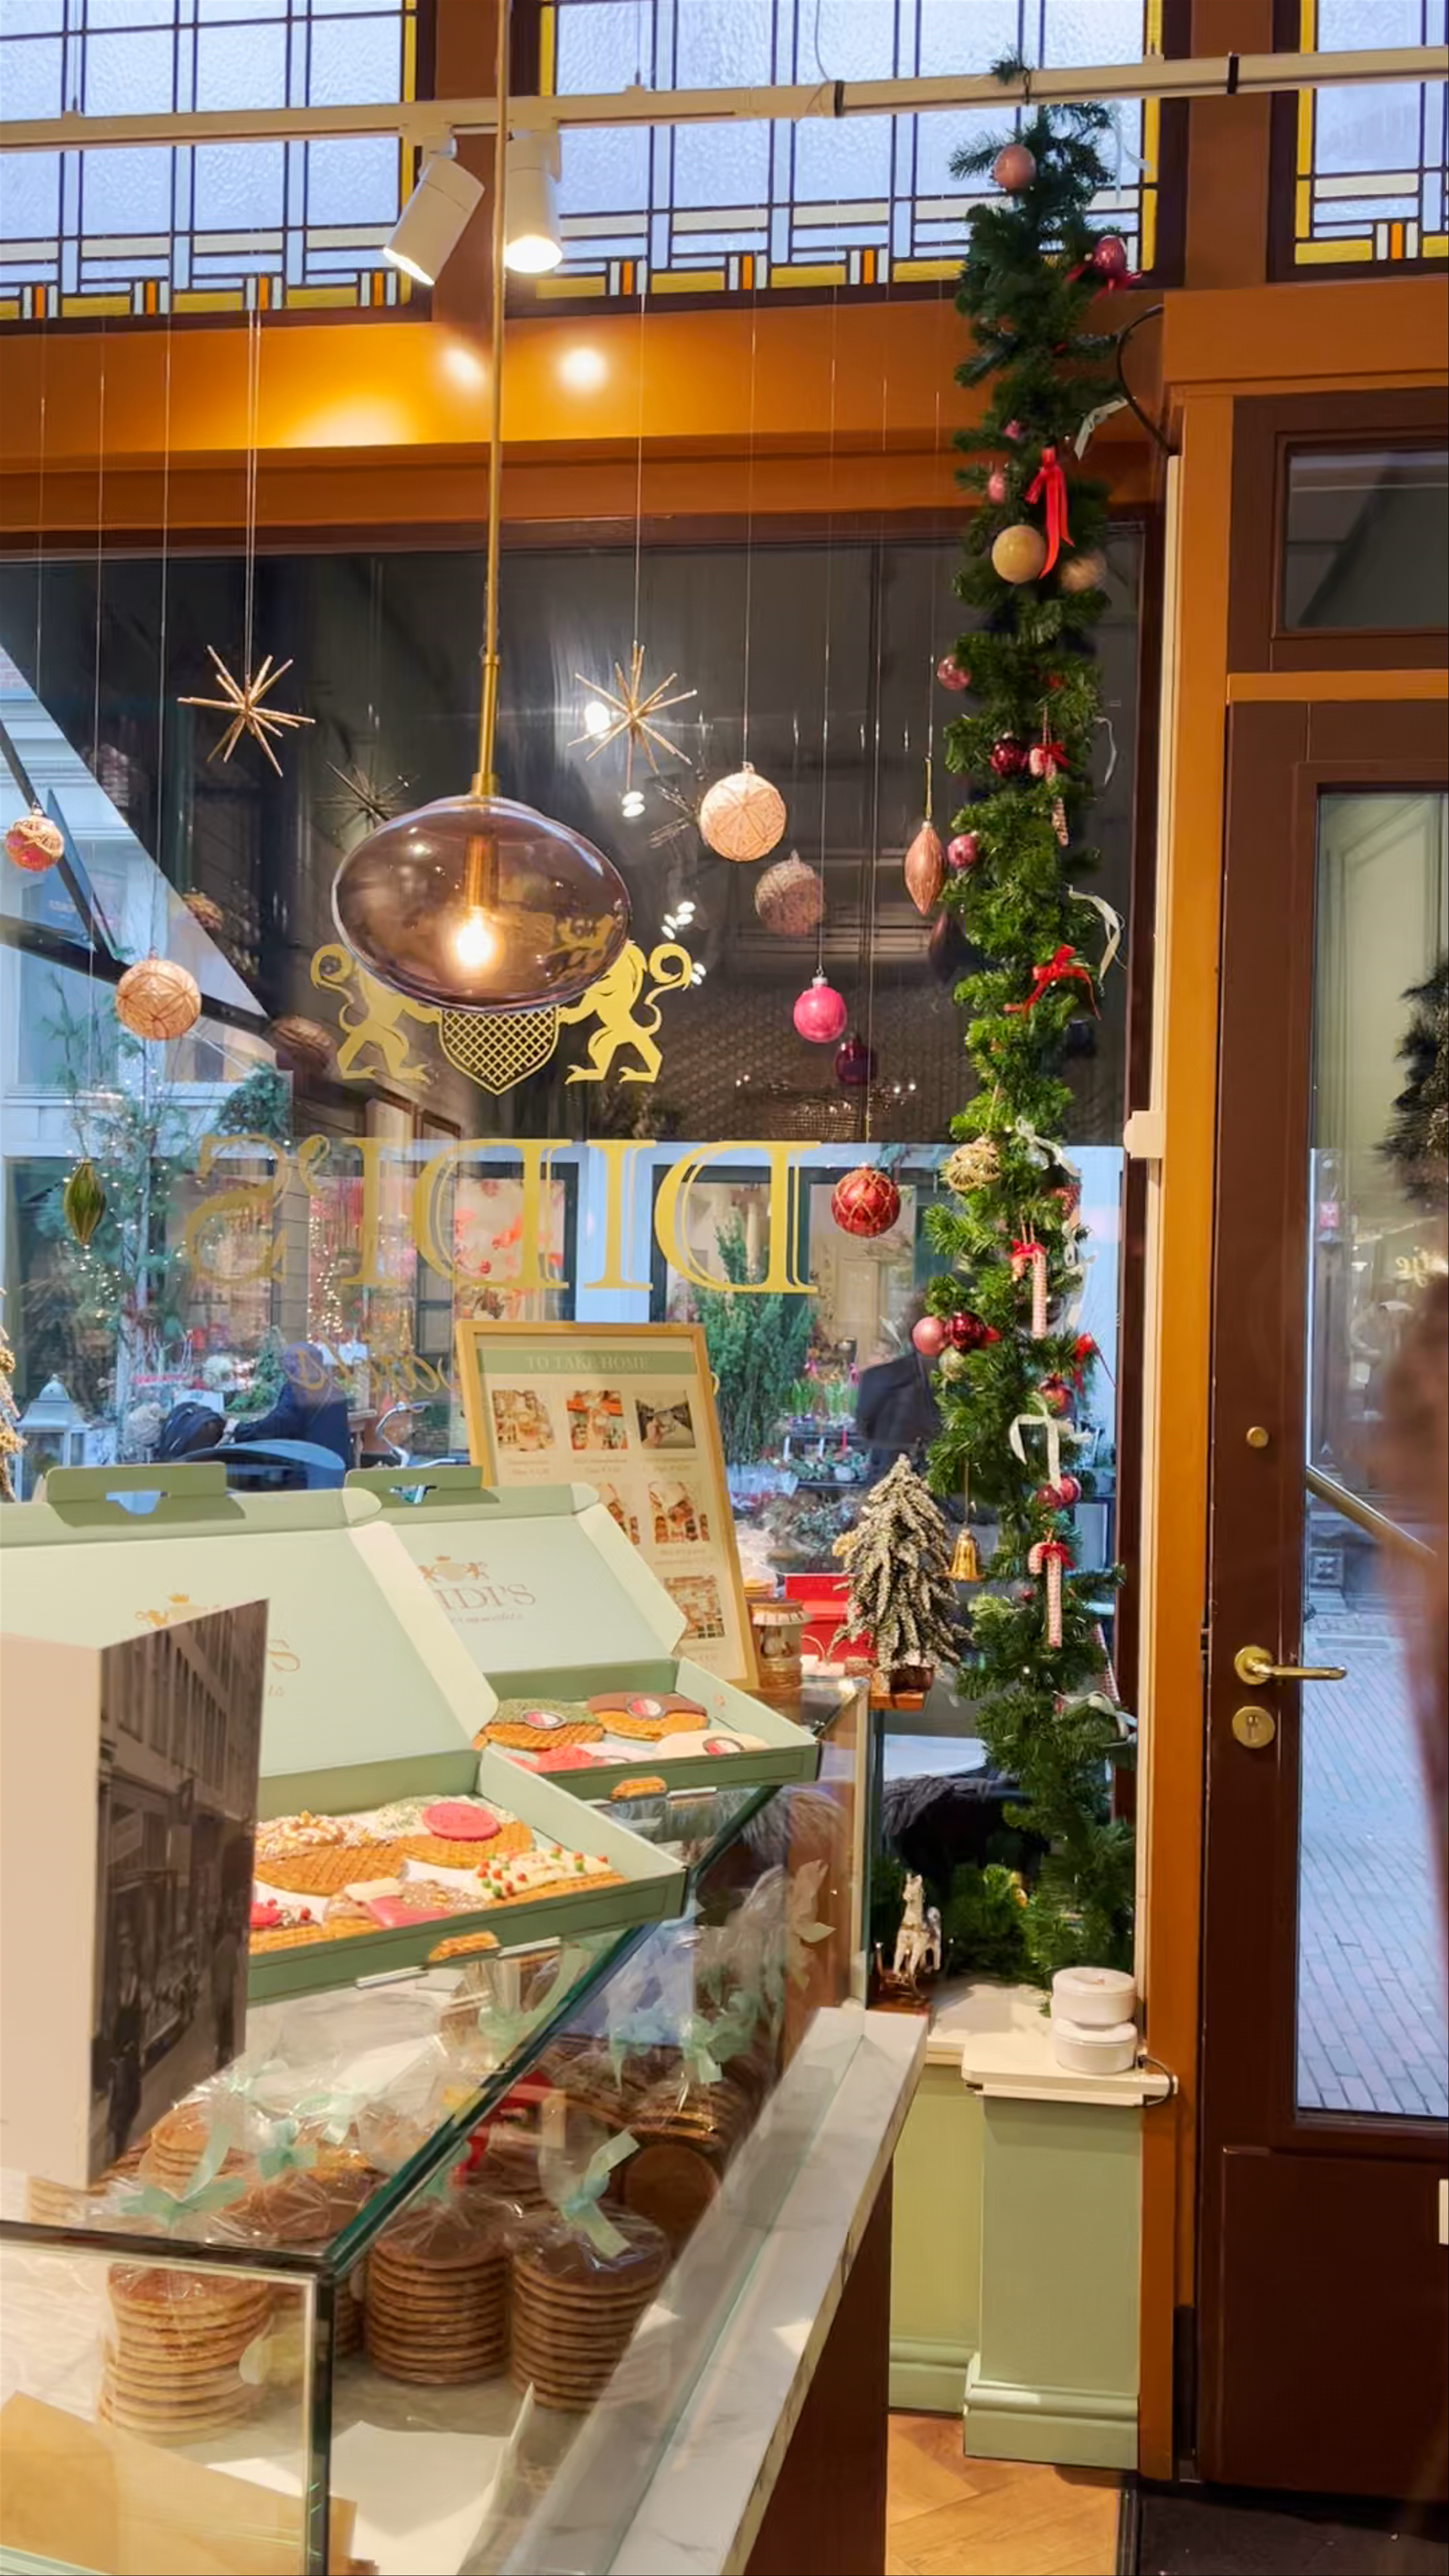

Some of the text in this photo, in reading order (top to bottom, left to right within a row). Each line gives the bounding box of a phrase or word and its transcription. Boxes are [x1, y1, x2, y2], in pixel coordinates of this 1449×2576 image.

[526, 1356, 648, 1370] TO TAKE HOME
[432, 1584, 536, 1610] IDI'S
